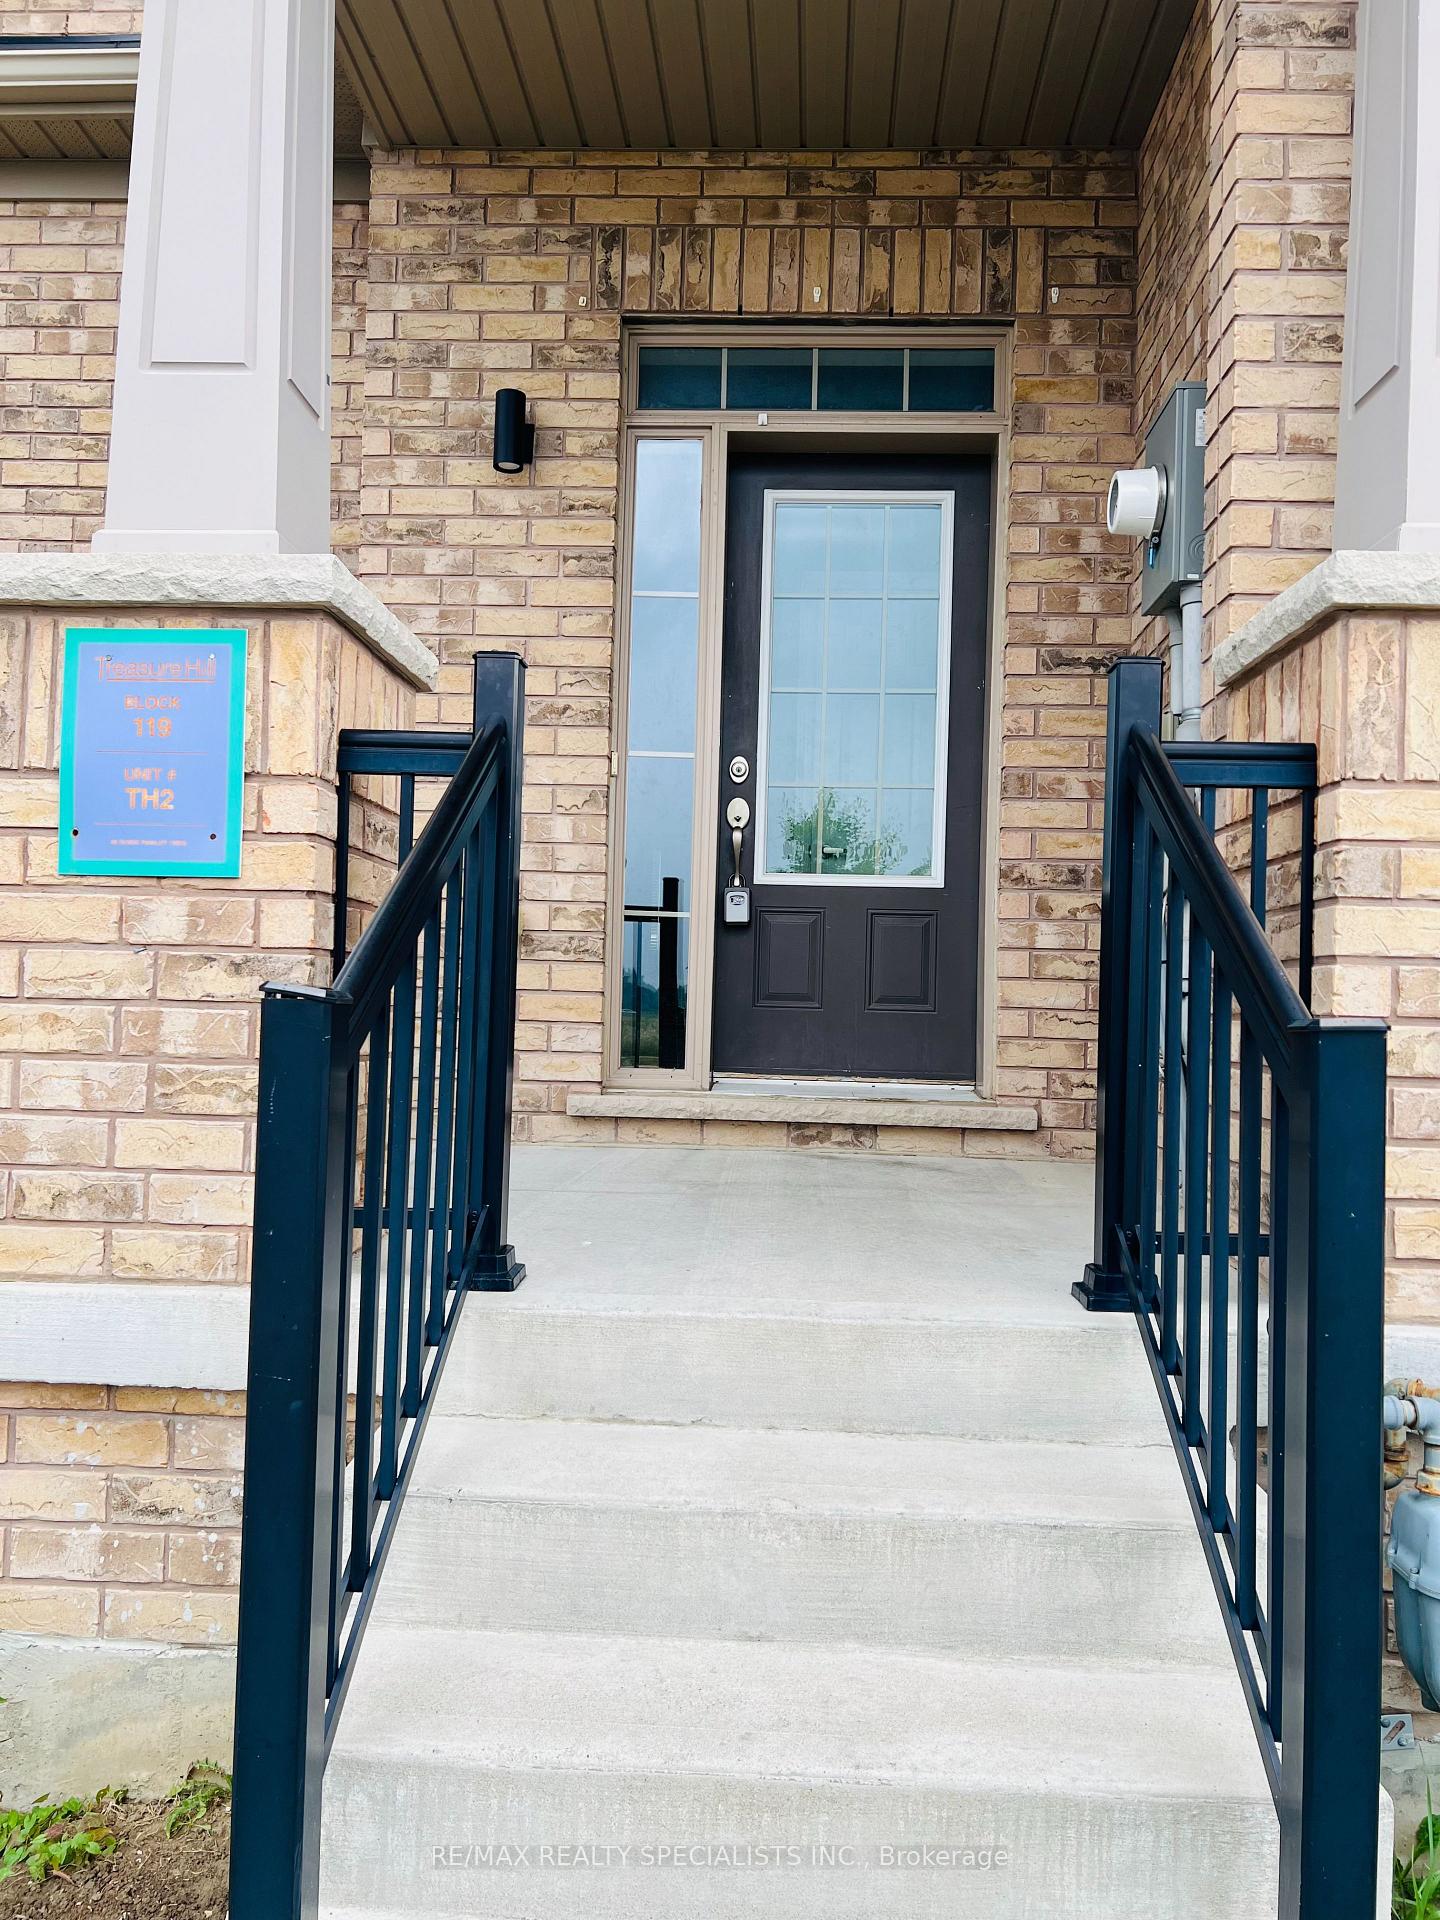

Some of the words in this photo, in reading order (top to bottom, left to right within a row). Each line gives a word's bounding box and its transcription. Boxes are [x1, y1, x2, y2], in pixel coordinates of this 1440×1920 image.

[124, 695, 181, 710] BLOCK
[124, 767, 162, 781] UNIT
[124, 787, 175, 810] TH2
